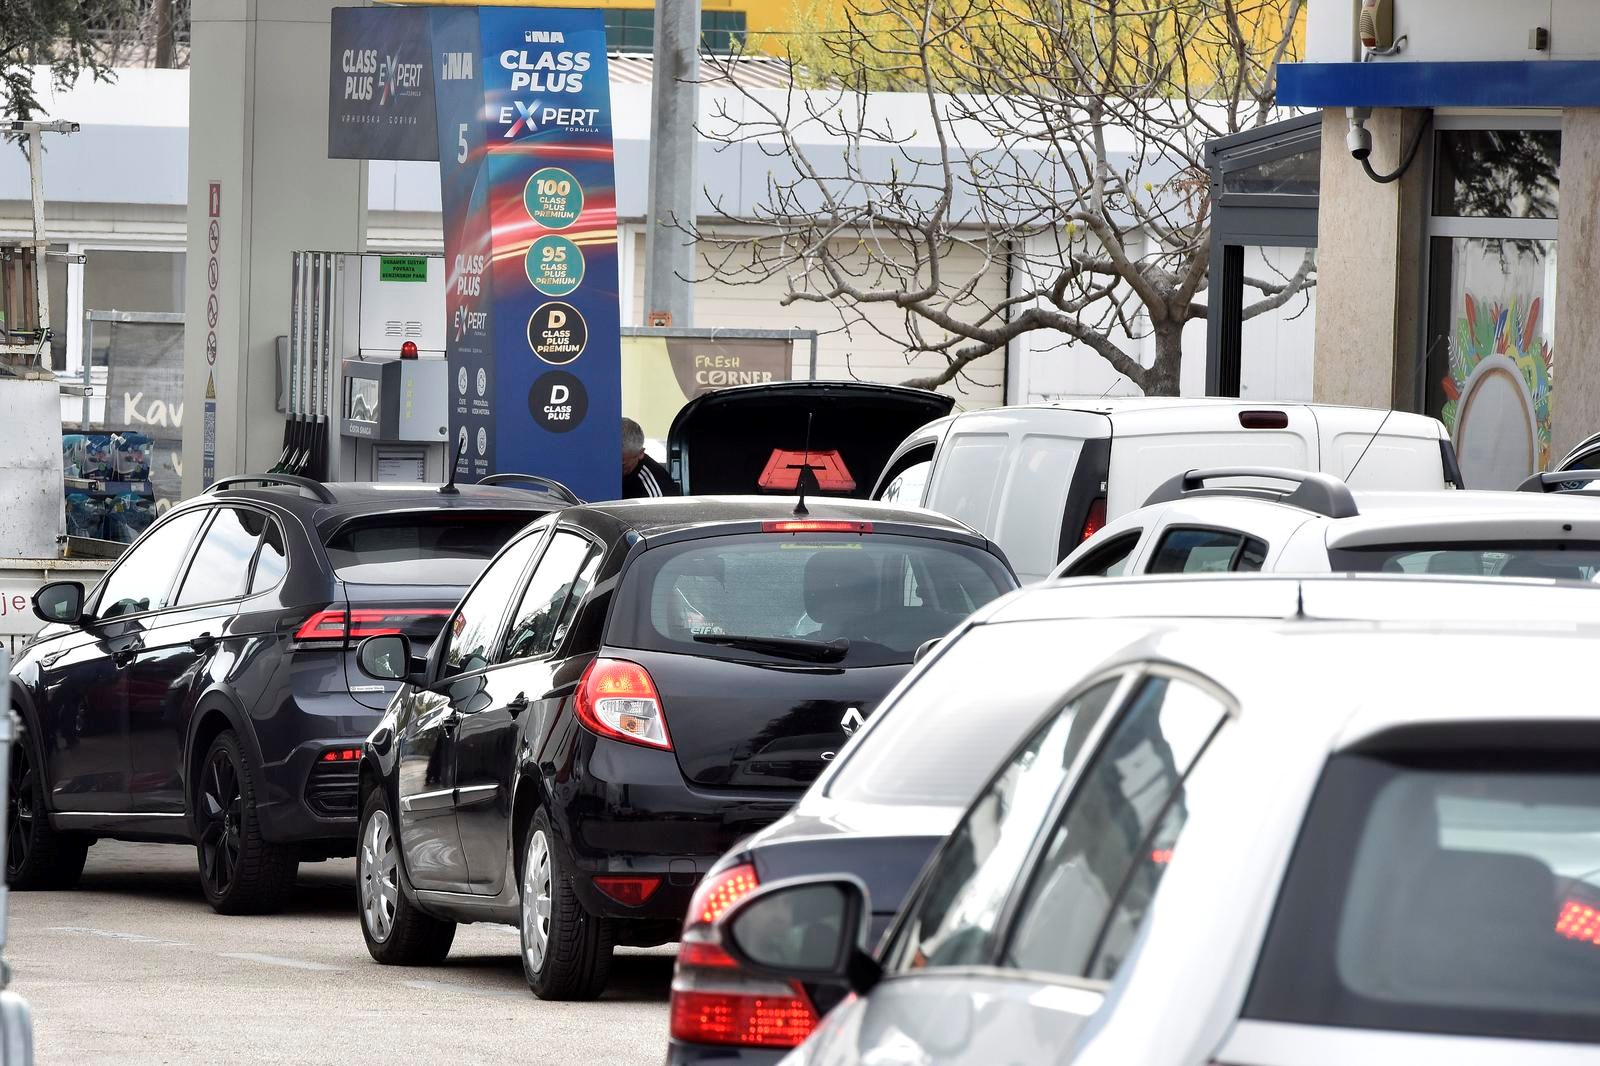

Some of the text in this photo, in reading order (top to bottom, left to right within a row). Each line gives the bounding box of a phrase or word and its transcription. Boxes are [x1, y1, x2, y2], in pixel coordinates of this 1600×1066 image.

[342, 49, 378, 73] CLASS
[500, 50, 591, 71] CLASS
[345, 76, 373, 100] PLUS
[378, 55, 423, 105] EXPERT
[511, 72, 583, 93] PLUS
[499, 99, 600, 137] EXPERT
[457, 123, 468, 164] 5
[537, 180, 570, 196] 100
[540, 196, 567, 205] CLASS
[534, 210, 574, 219] PREMIUM
[542, 246, 567, 262] 95
[455, 254, 484, 274] CLASS
[540, 263, 568, 271] CLASS
[536, 277, 576, 285] PREMIUM
[544, 270, 566, 278] PLUS
[457, 276, 480, 296] PLUS
[454, 304, 487, 342] EXPERT
[548, 310, 566, 329] D
[542, 330, 570, 338] CLASS
[546, 337, 569, 345] PLUS
[537, 344, 580, 353] PREMIUM
[695, 354, 740, 368] FRESH
[695, 370, 772, 385] CORNER
[550, 384, 569, 404] D
[543, 405, 571, 413] CLASS
[547, 412, 570, 420] PLUS
